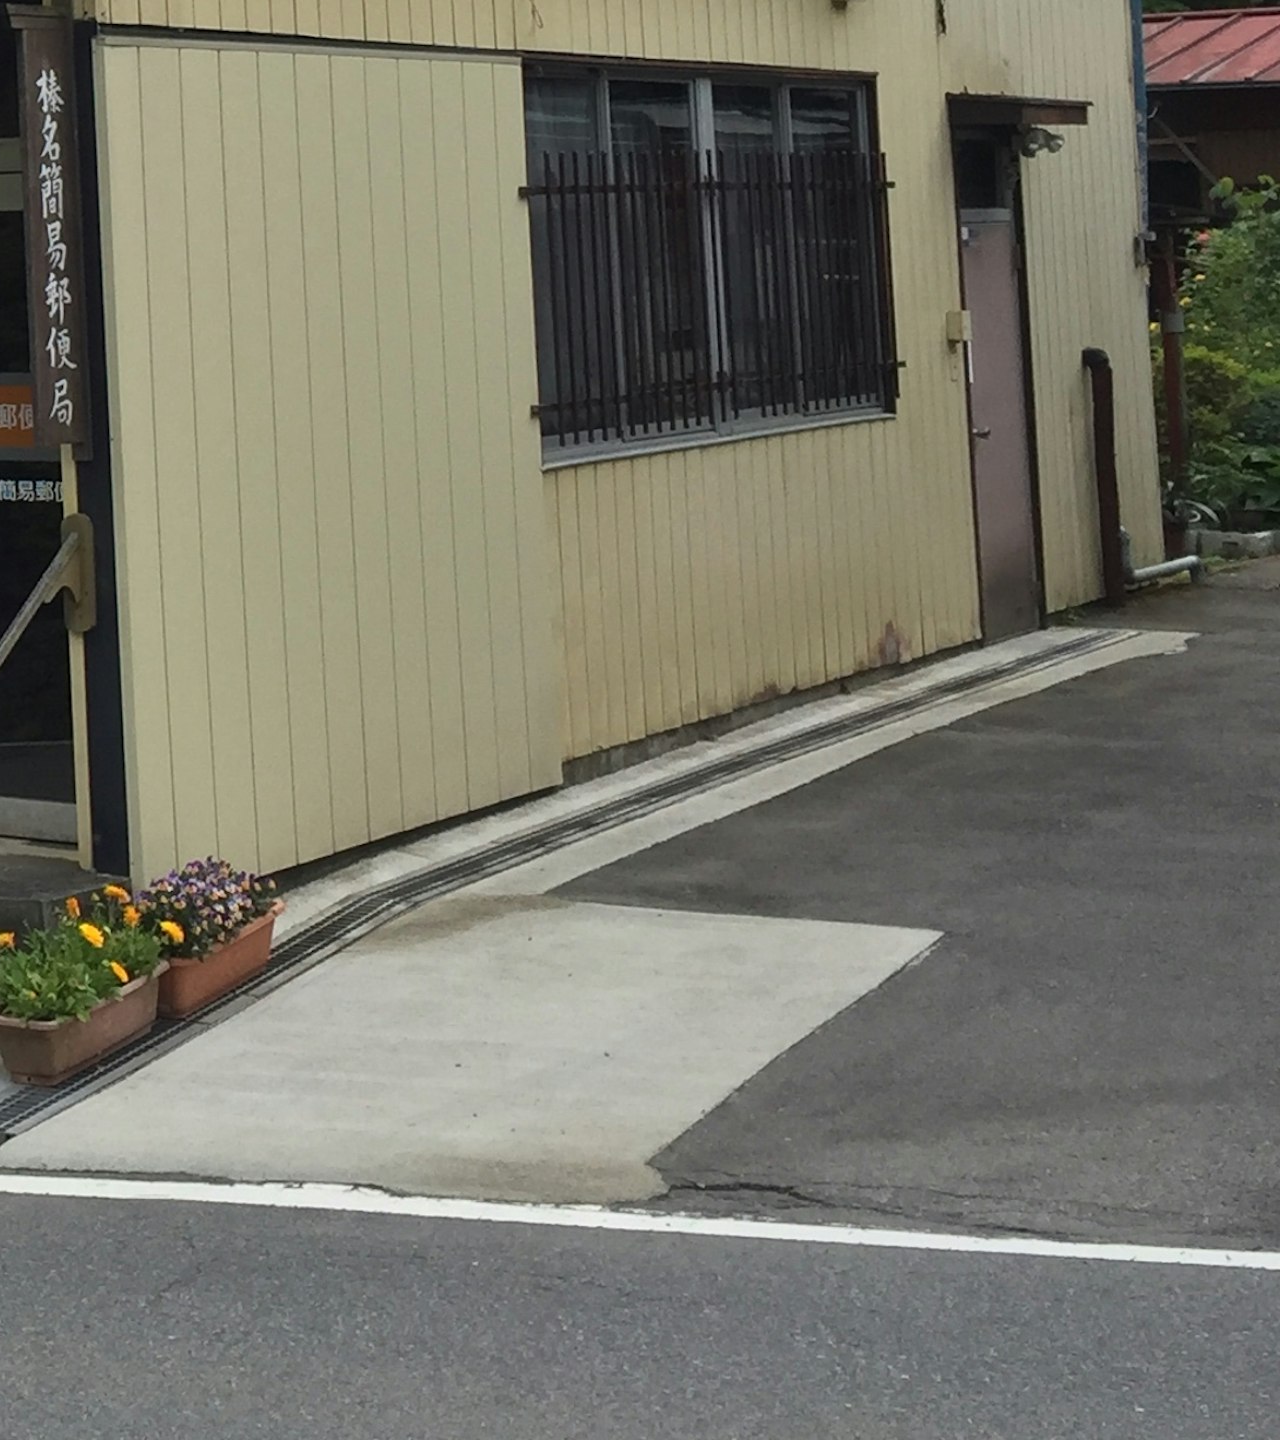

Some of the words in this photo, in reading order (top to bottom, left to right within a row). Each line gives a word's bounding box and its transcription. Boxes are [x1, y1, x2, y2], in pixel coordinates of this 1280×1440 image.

[35, 68, 78, 427] 榛名簡易郵便局
